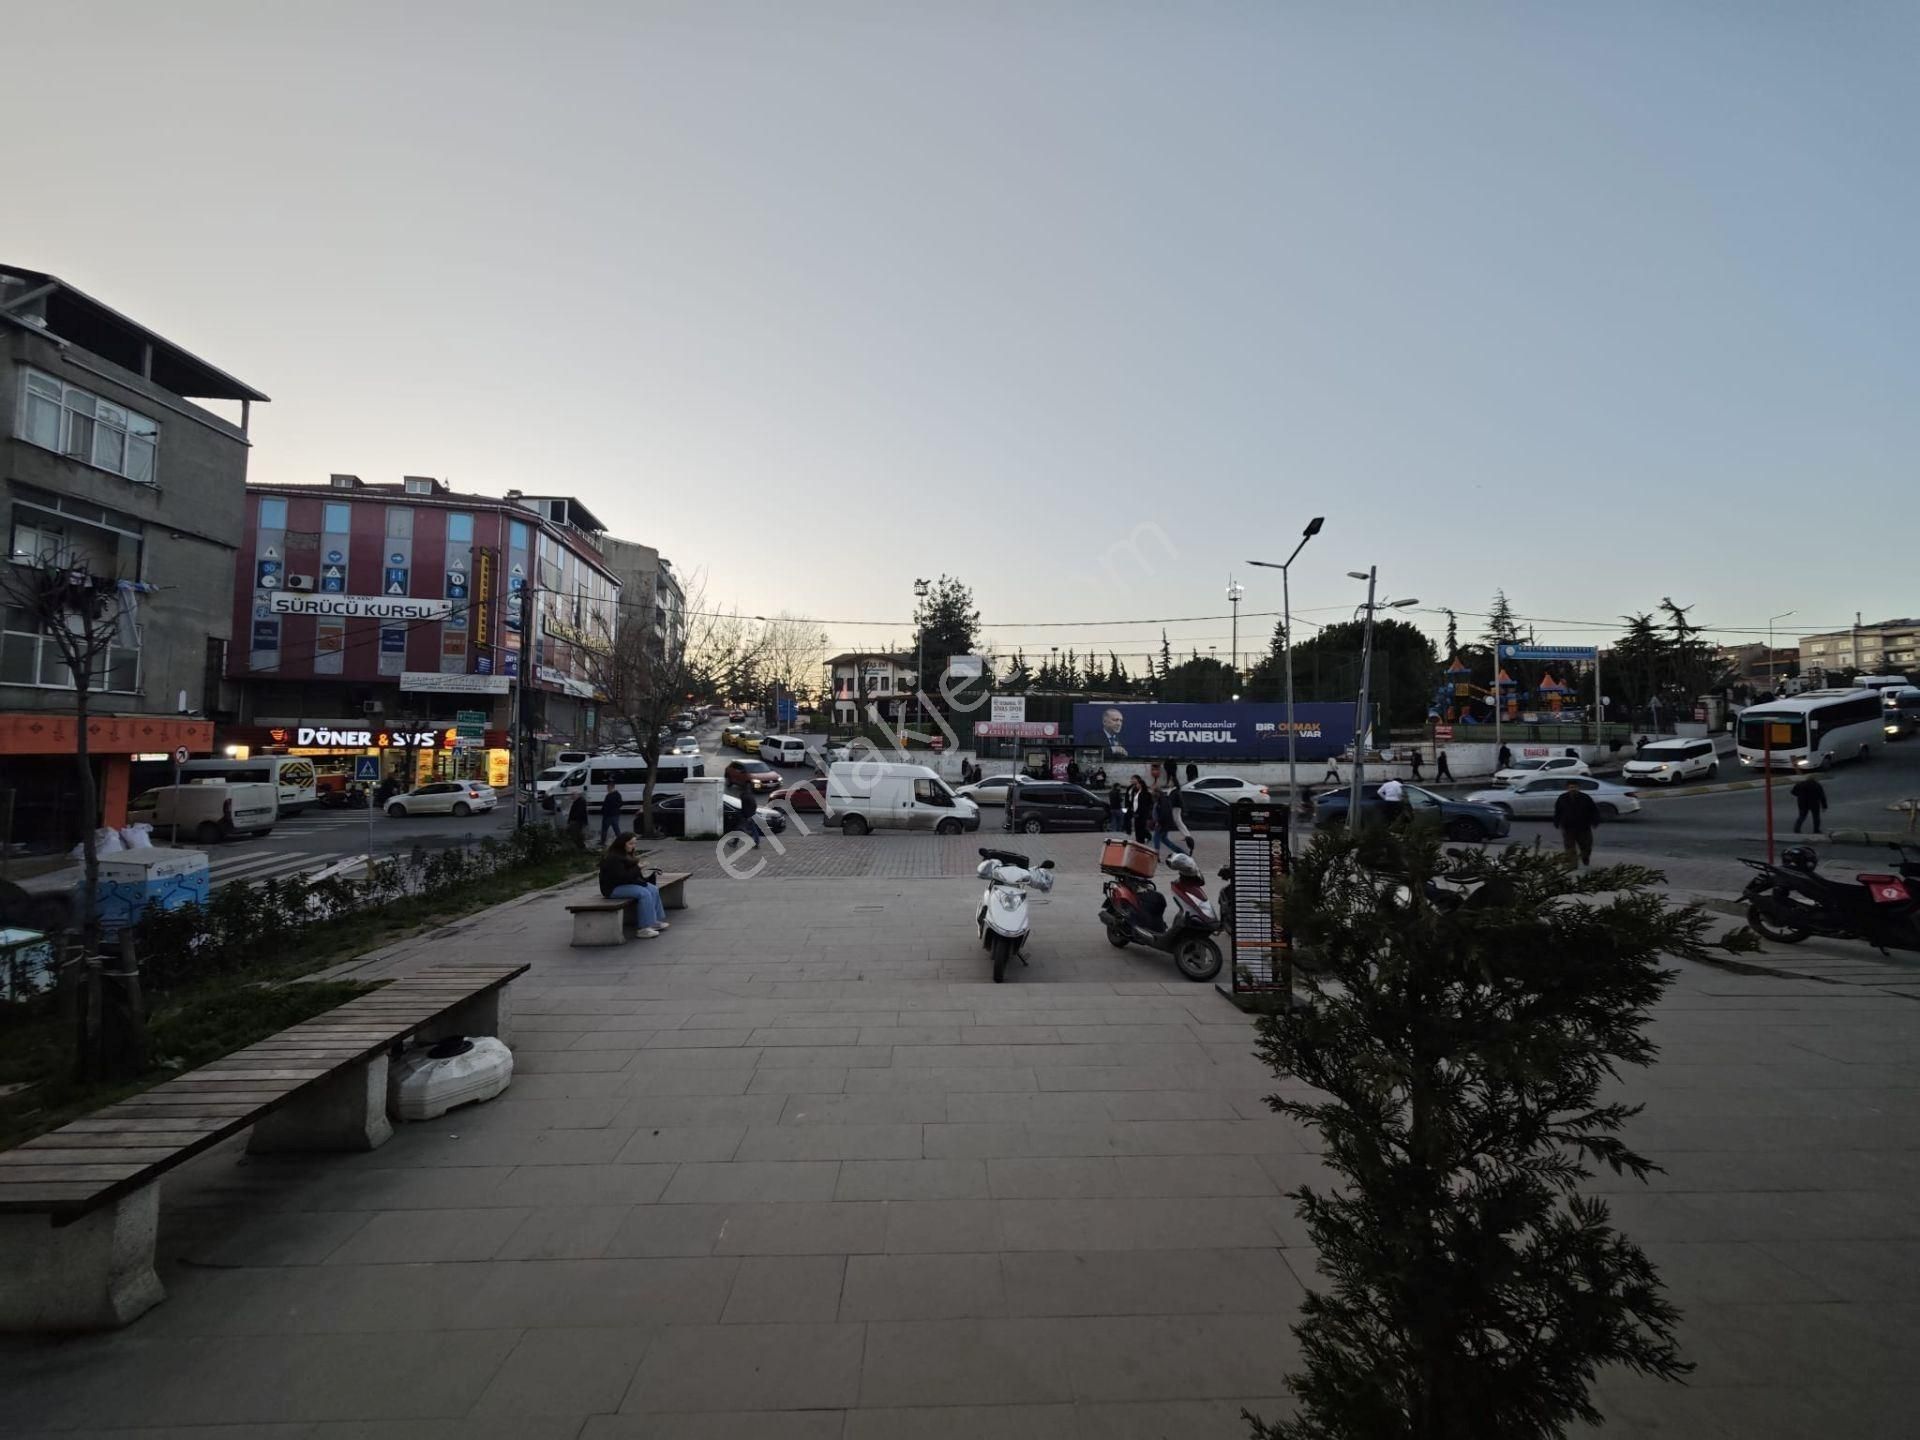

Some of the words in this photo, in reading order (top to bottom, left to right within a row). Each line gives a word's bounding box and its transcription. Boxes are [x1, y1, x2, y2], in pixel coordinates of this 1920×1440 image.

[276, 598, 359, 615] SÜRÜCÜ
[364, 604, 431, 618] KURSU
[1149, 720, 1180, 731] Hayırlı
[1181, 720, 1237, 729] Ramazanlar
[298, 727, 372, 746] DÖNER
[378, 733, 389, 746] &
